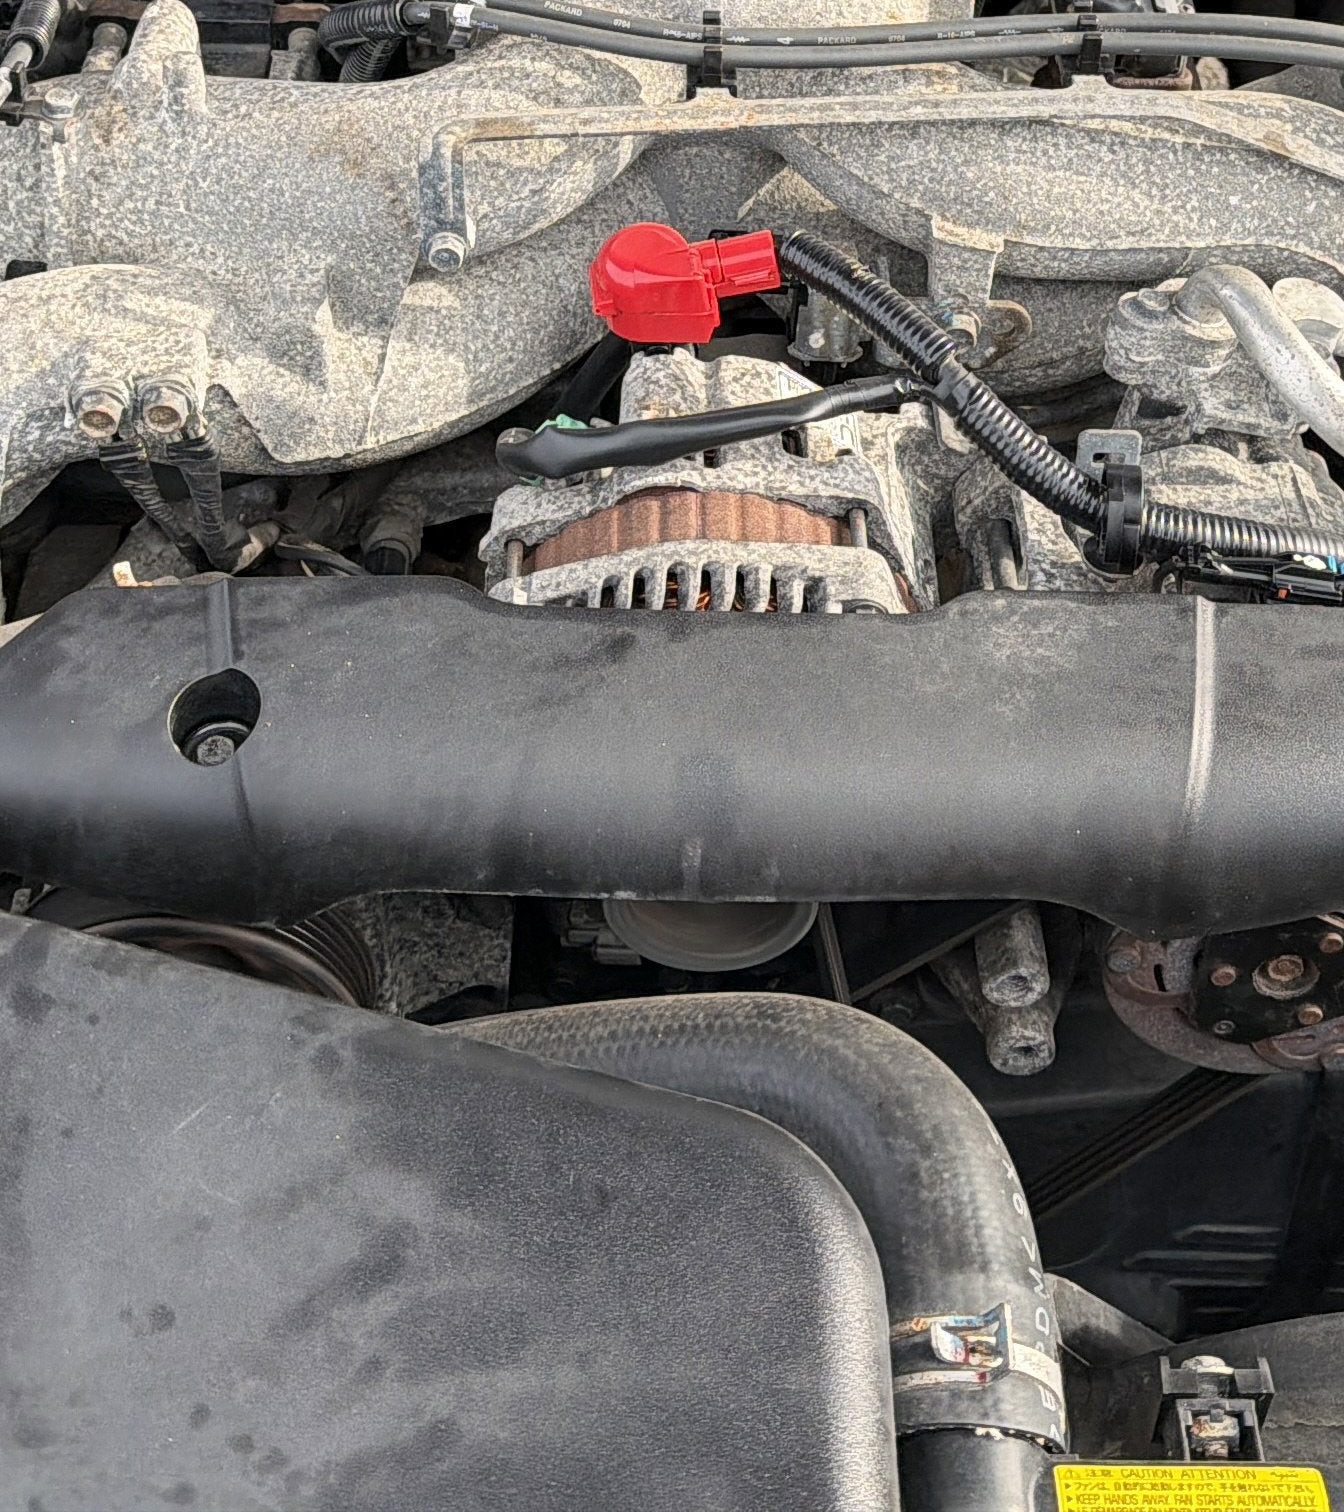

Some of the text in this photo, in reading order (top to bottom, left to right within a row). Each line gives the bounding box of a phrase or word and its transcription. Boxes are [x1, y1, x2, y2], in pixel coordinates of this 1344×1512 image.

[544, 0, 583, 17] PACKARD
[817, 35, 857, 45] PACKARD
[1120, 1469, 1257, 1480] CAUTION ATTENTION
[1076, 1493, 1101, 1505] KEEP
[1103, 1494, 1138, 1505] HANDS
[1196, 1494, 1234, 1506] STARTS
